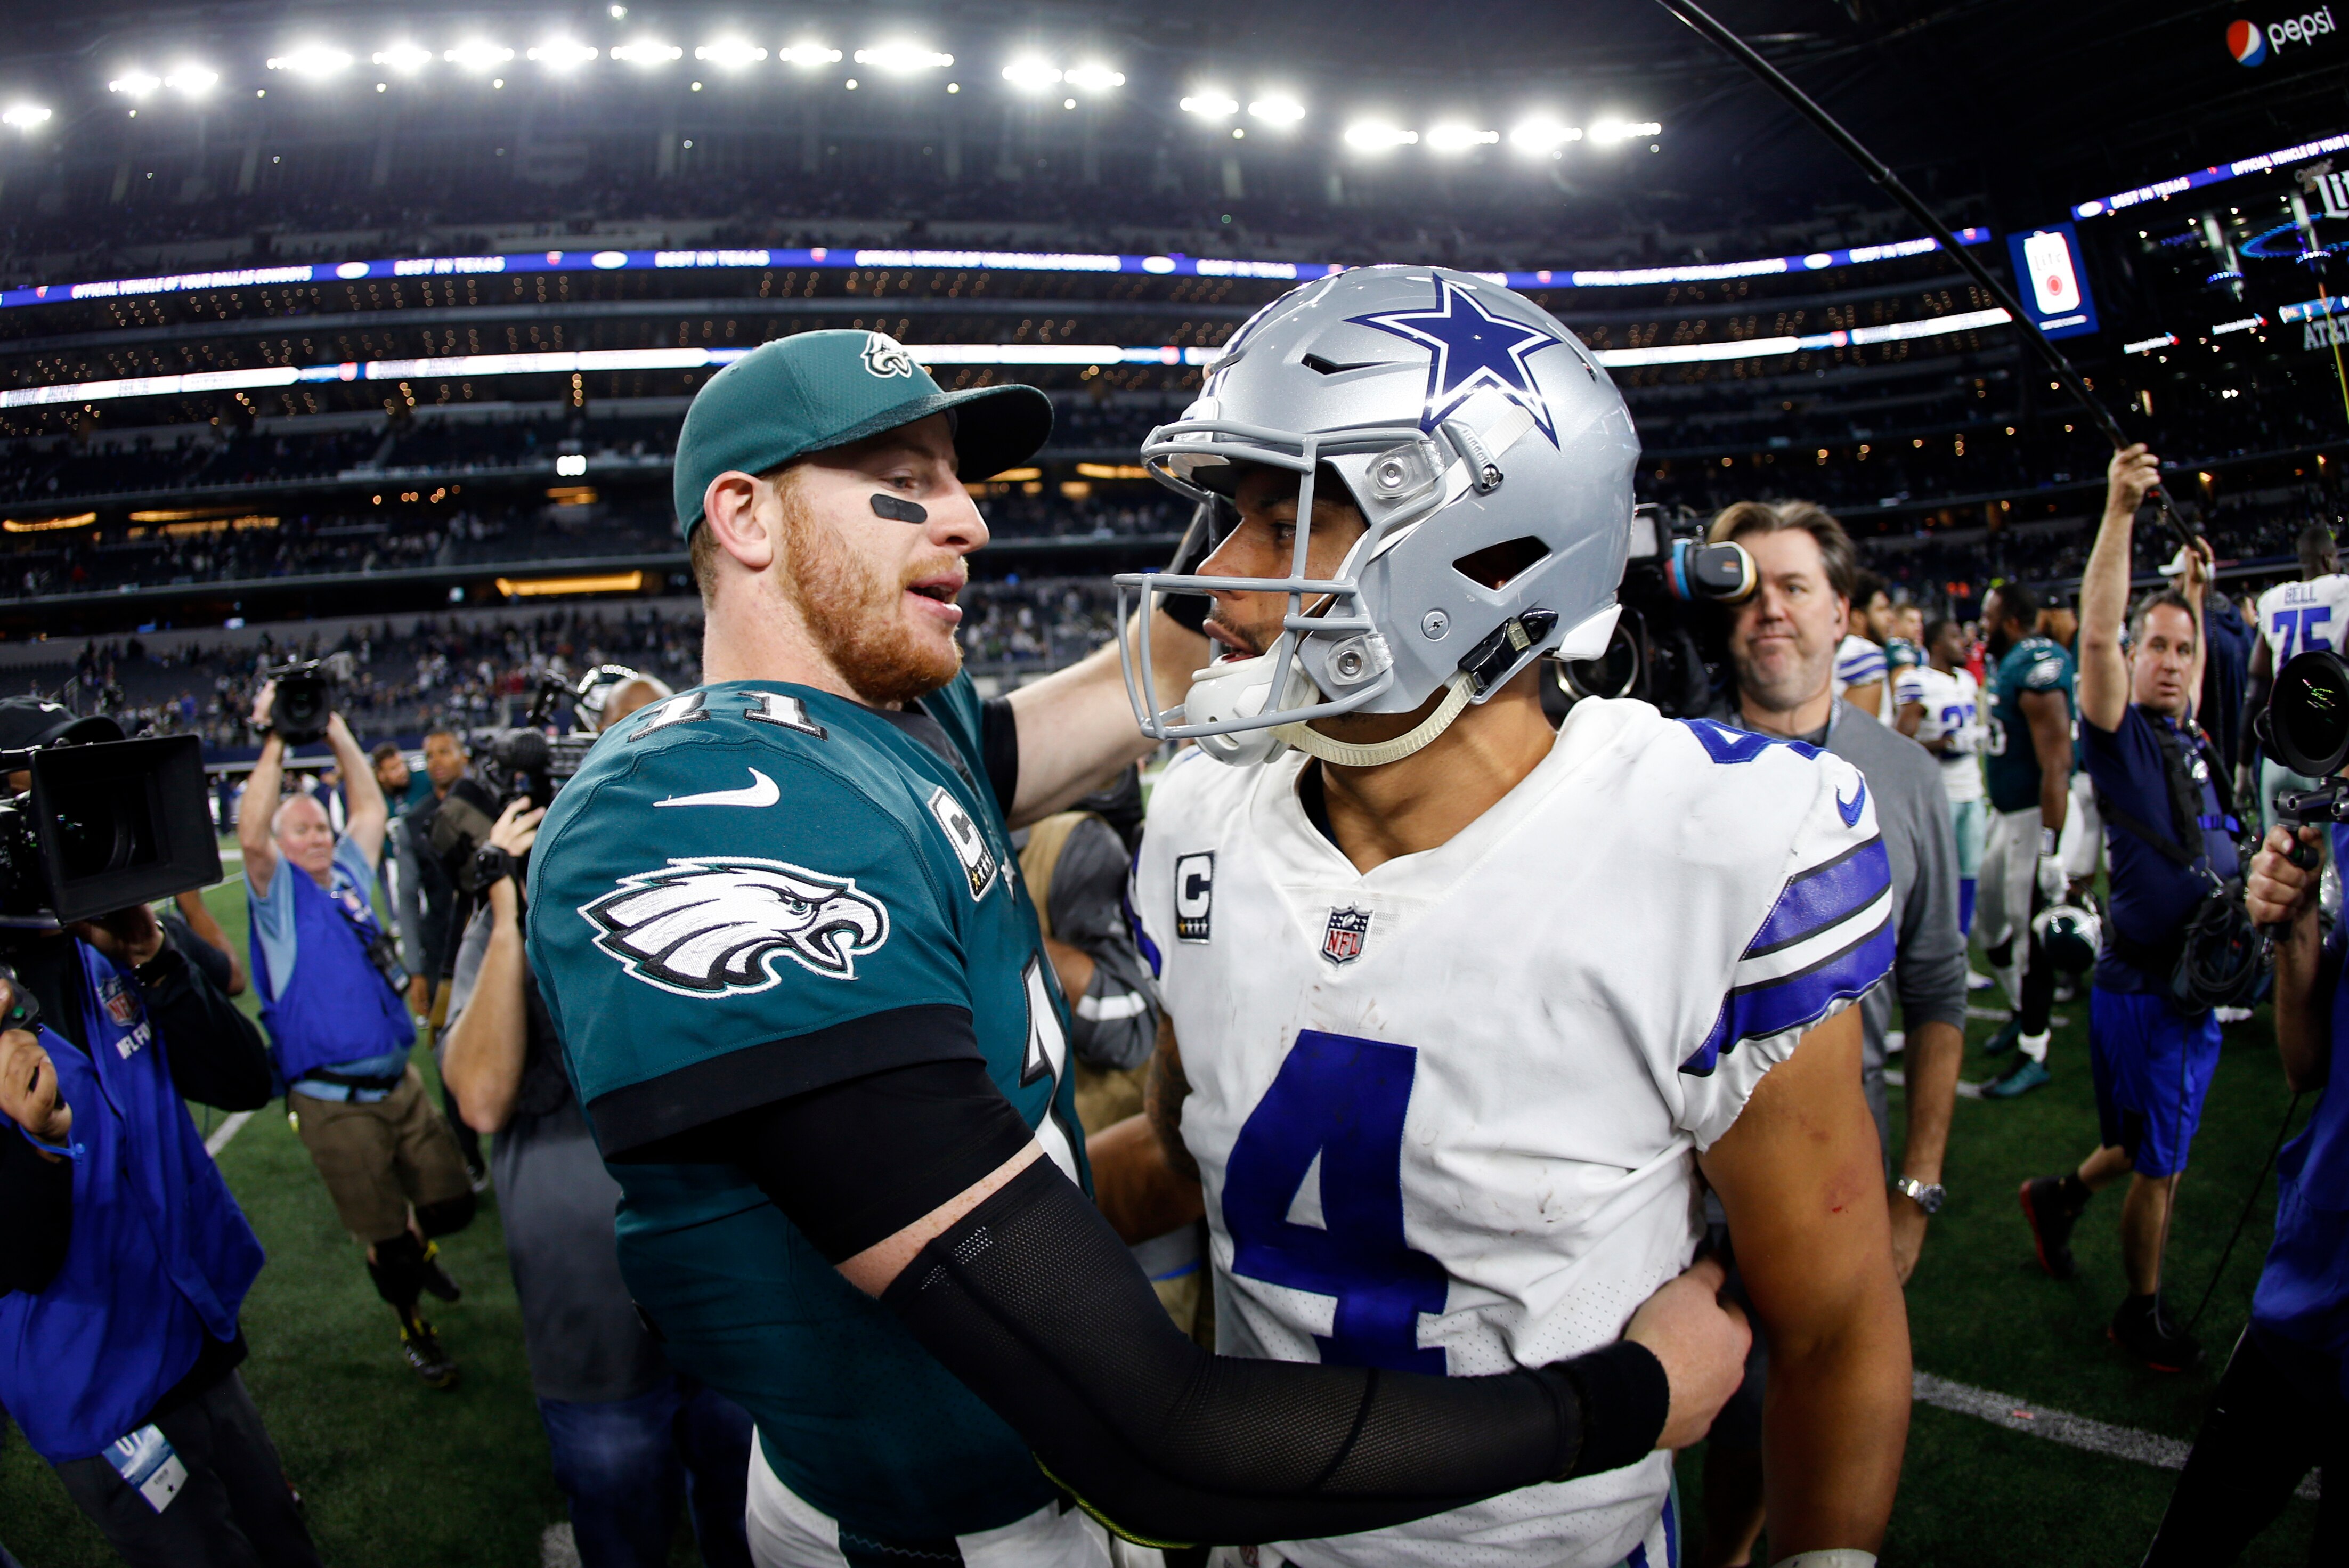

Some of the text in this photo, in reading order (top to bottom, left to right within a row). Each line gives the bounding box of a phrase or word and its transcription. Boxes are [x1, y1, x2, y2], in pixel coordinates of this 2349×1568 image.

[2267, 5, 2335, 55] pepsi
[2319, 136, 2345, 153] YOUR
[2110, 177, 2191, 209] BEST IN TEXAS
[2285, 584, 2317, 604] BELL
[2272, 606, 2332, 672] 75
[628, 690, 828, 743] 11
[936, 794, 983, 868] C
[1176, 855, 1212, 918] C
[1326, 930, 1360, 958] NFL
[1221, 1028, 1449, 1377] 4
